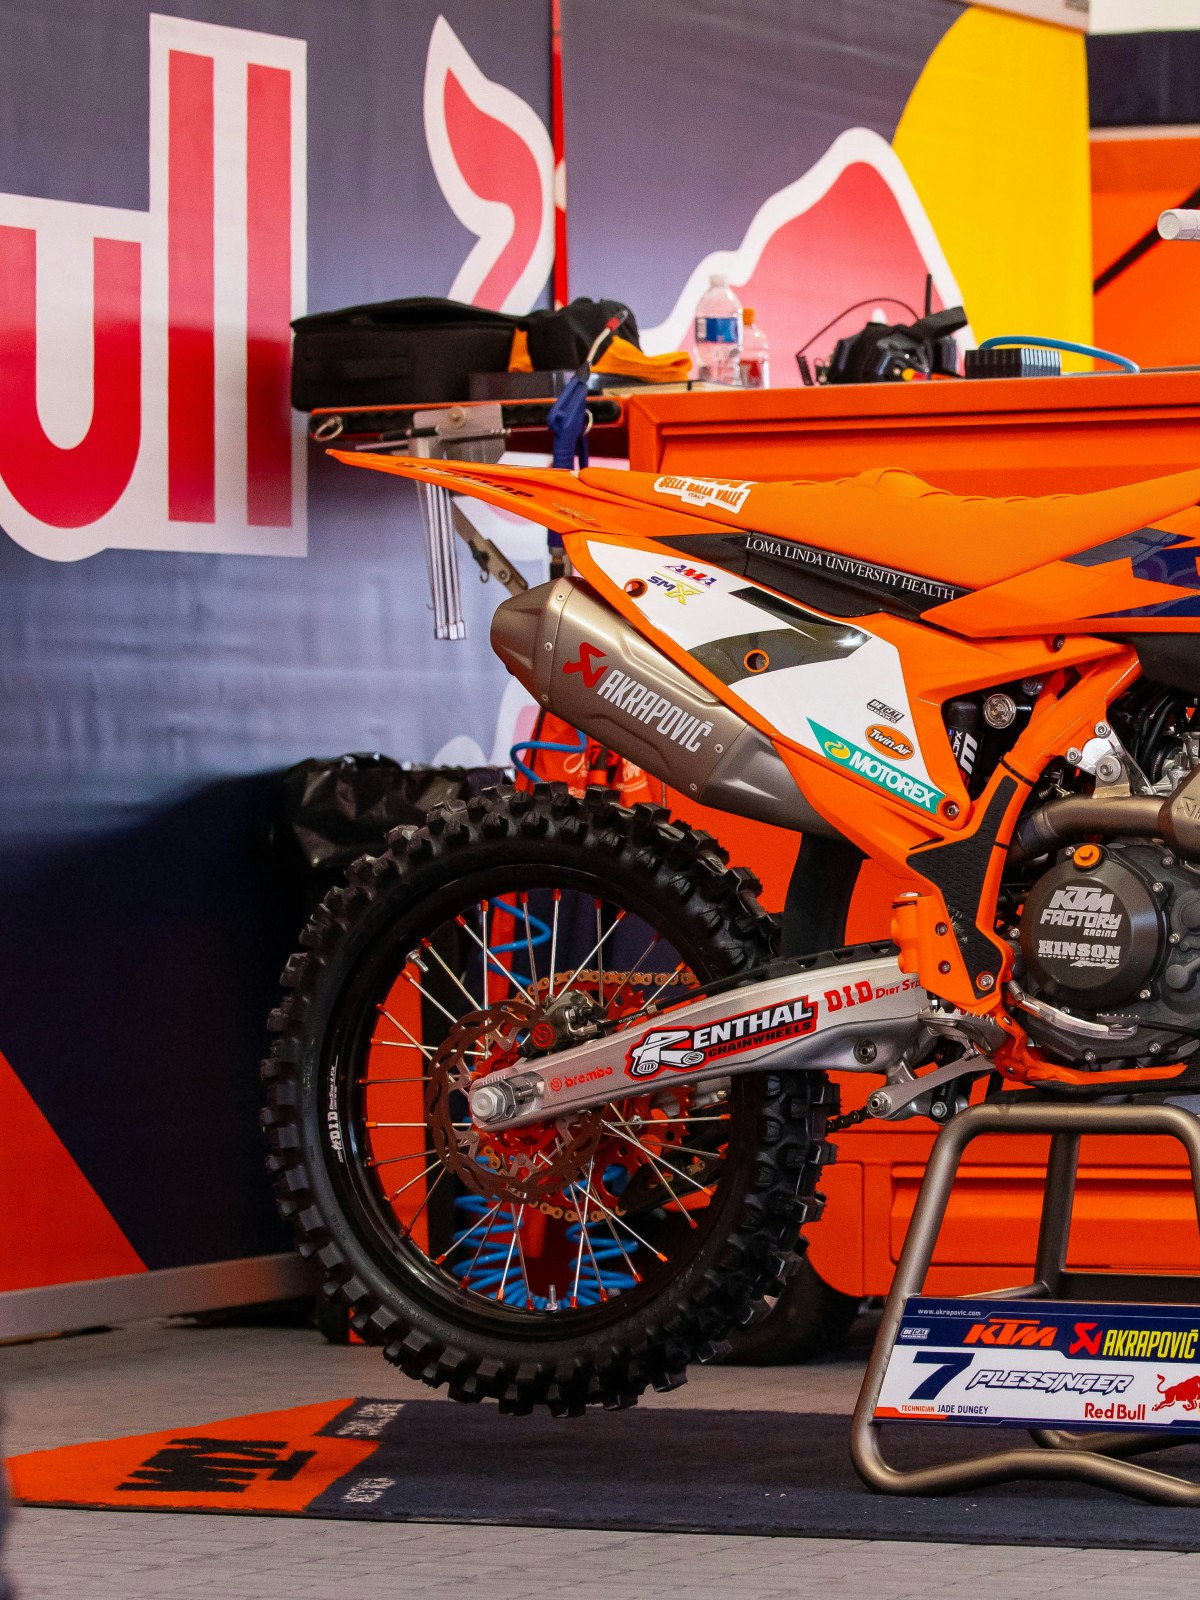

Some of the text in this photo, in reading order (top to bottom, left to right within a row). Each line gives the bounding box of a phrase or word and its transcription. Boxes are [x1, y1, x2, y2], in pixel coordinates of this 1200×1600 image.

[659, 477, 687, 490] SELLE
[715, 489, 744, 507] VALLE
[687, 492, 705, 500] ITALY
[664, 564, 717, 588] AMA
[745, 537, 955, 600] LOMA LINDA UNIVERSITY HEALTH
[868, 728, 913, 756] Twin Air
[849, 751, 937, 808] MOTOREX
[1049, 886, 1114, 912] KTM
[1040, 909, 1122, 929] FACTORY
[1083, 929, 1118, 938] RACING
[1038, 940, 1121, 959] HINSON
[824, 980, 873, 1013] D.I.D
[631, 1000, 814, 1077] RENTHAL
[708, 1021, 812, 1058] CHAINWHEELS
[564, 1067, 613, 1088] brembo
[918, 1308, 982, 1317] www.akrapovic.com
[962, 1319, 1059, 1346] KTM
[909, 1351, 976, 1400] 7
[965, 1369, 1135, 1396] PLESSINGER
[901, 1404, 989, 1415] TECHNICIAN JADE DUNGEY
